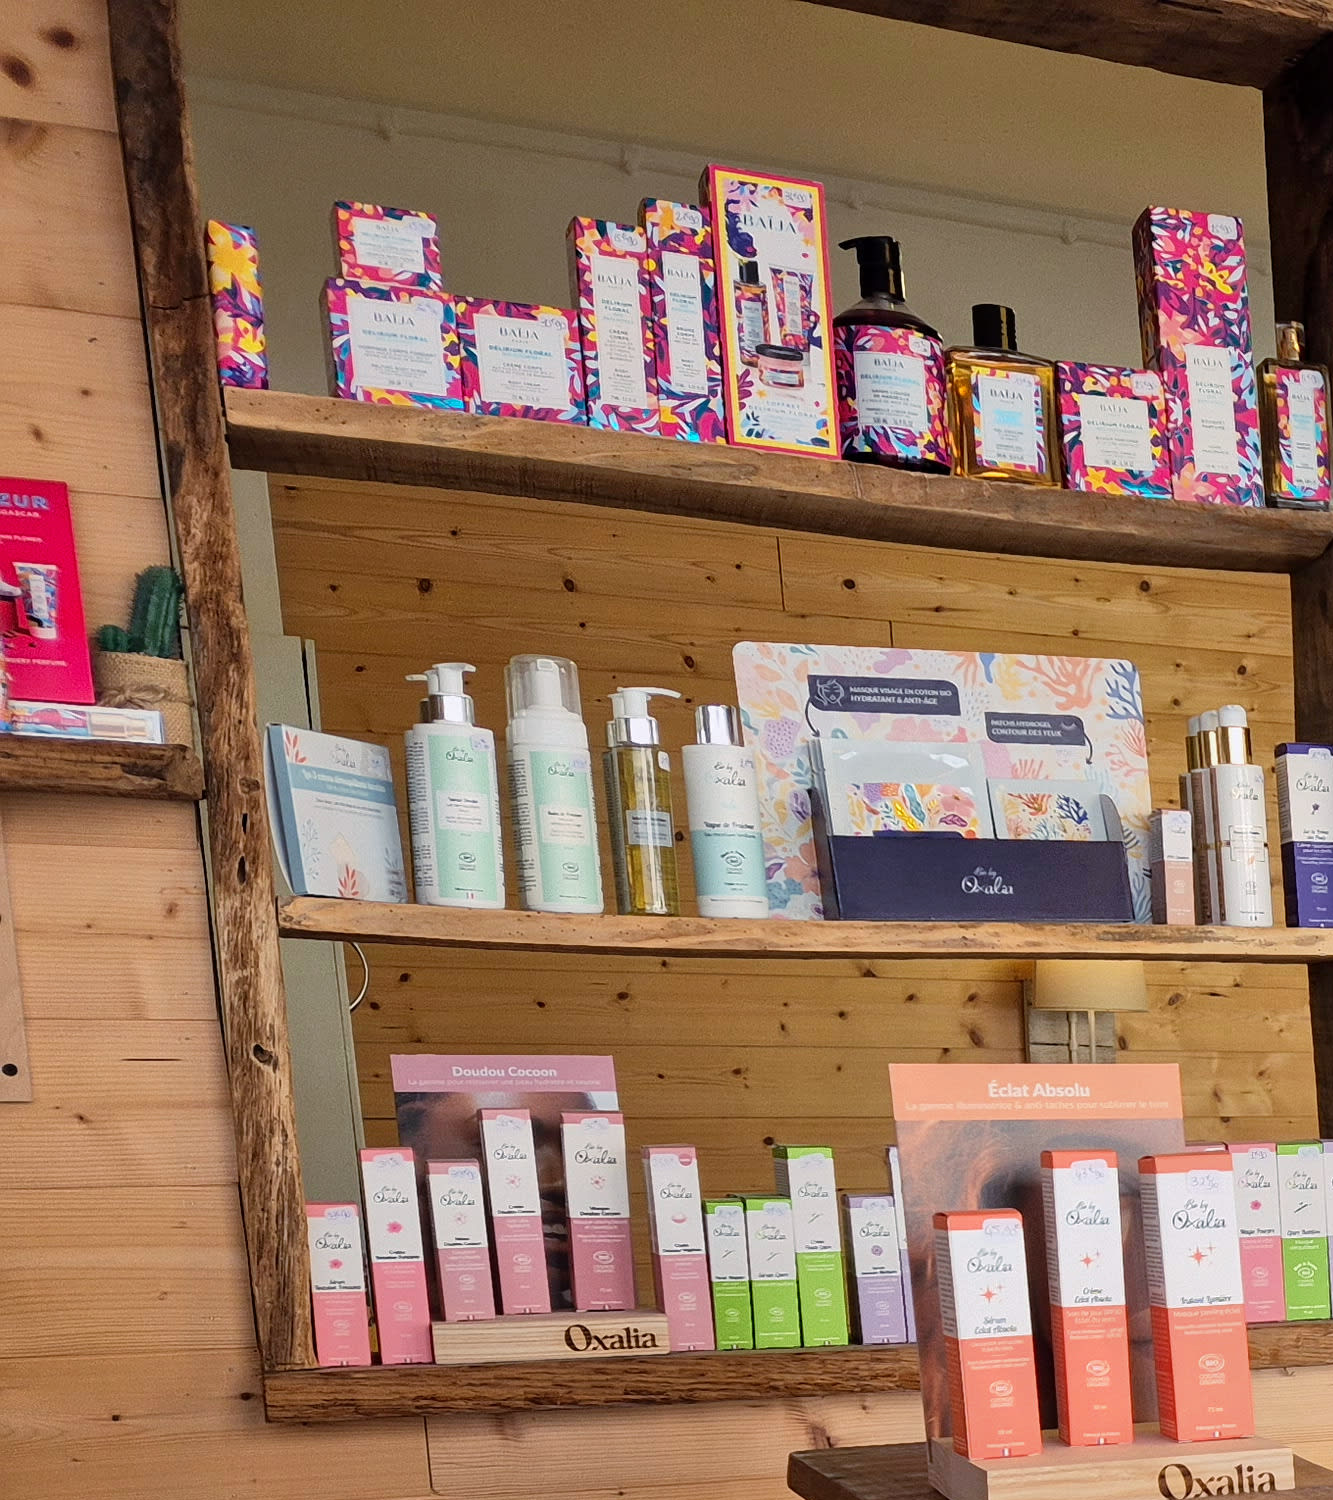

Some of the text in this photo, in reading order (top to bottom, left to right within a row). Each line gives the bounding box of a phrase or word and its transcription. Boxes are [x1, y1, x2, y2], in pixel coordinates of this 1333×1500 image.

[743, 212, 797, 234] BAÏJA
[597, 274, 633, 287] BAÏJA
[500, 327, 539, 340] BAÏJA
[874, 357, 904, 369] BAÏJA
[990, 387, 1023, 401] BAÏJA
[850, 695, 894, 704] HYDRATANT
[992, 728, 1027, 737] CONTOUR
[452, 1066, 557, 1077] Doudou Cocoon
[987, 1080, 1091, 1098] Éclat Absolu
[1066, 1209, 1110, 1226] Oxalia
[1172, 1209, 1226, 1230] Oxalia
[984, 1316, 1007, 1325] Sérum
[564, 1324, 659, 1351] Oxalia
[1158, 1463, 1277, 1500] Oxalia
